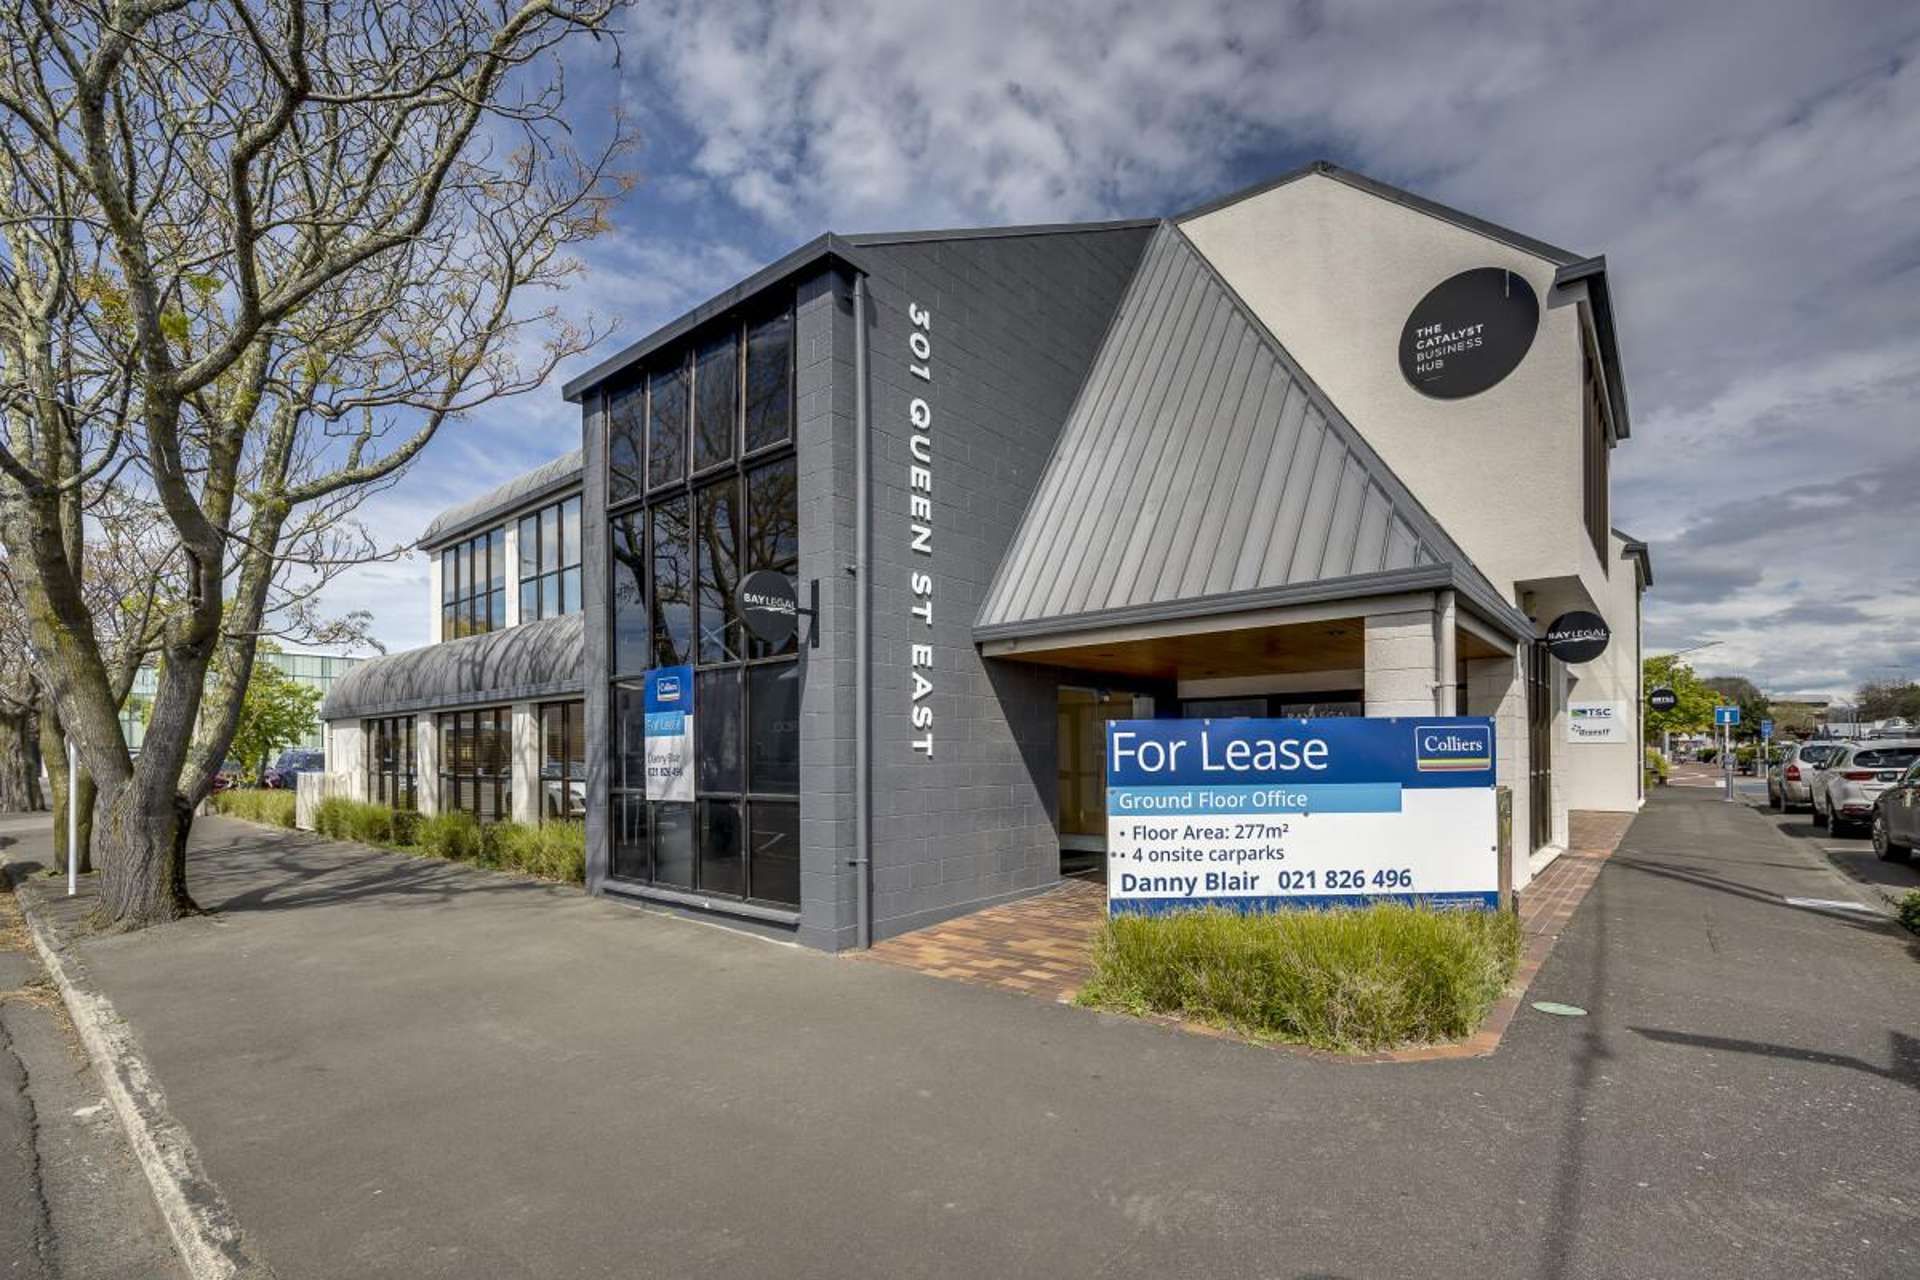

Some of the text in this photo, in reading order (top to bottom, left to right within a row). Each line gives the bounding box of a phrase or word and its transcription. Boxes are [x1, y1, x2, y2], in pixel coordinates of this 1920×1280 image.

[1416, 323, 1442, 338] THE
[1416, 323, 1484, 350] CATALYST
[1416, 337, 1483, 362] BUSINESS
[1416, 359, 1444, 374] HUB
[909, 303, 933, 756] 301 QUEEN ST EAST
[1588, 708, 1612, 717] TSC
[1112, 731, 1329, 772] For Lease
[1424, 735, 1483, 752] Colliers
[1119, 790, 1308, 809] Ground Floor Office
[1132, 824, 1289, 841] Floor Area: 277m²
[1132, 844, 1285, 864] 4 onsite carparks
[1121, 868, 1412, 896] Danny Blair 021 826 496
